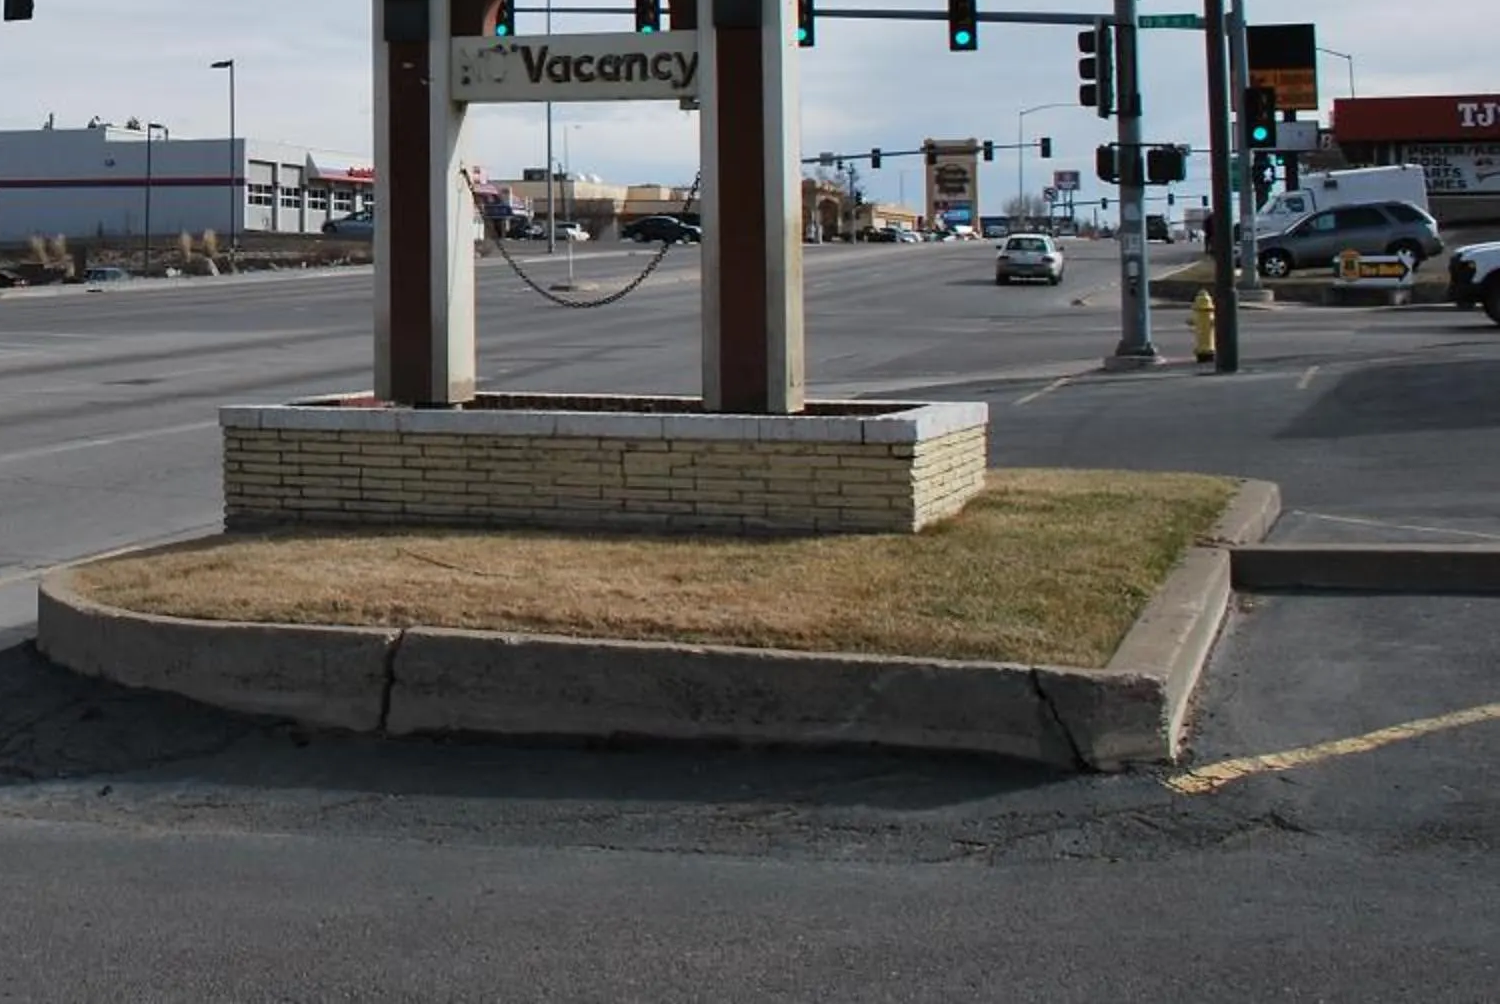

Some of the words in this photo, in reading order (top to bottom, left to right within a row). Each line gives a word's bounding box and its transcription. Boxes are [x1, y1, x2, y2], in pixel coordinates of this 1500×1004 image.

[519, 45, 699, 90] Vacancy
[1422, 167, 1461, 178] ARTS
[1425, 179, 1468, 190] AMES
